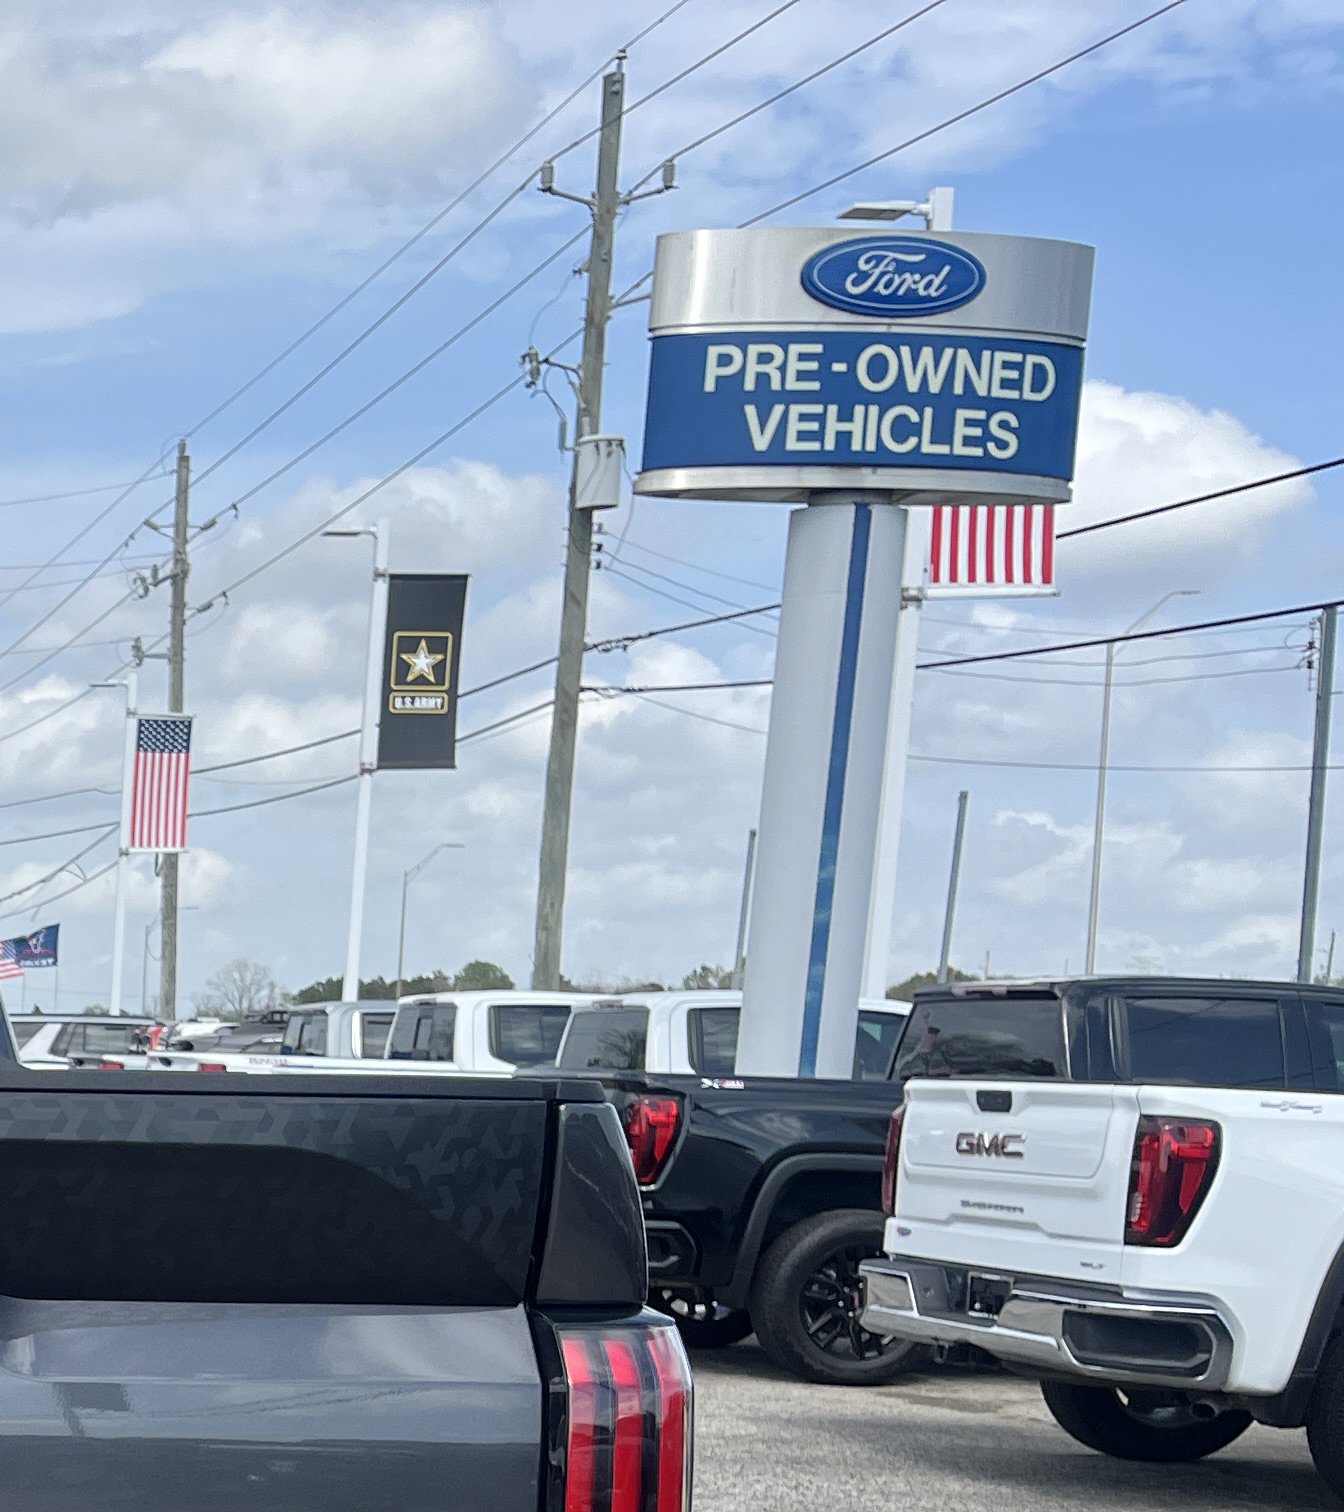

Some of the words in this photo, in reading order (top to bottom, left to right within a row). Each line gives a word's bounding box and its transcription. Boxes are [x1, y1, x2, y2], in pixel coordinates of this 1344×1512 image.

[845, 249, 953, 299] Ford
[743, 404, 1020, 460] VEHICLES
[955, 1132, 1025, 1158] GMC
